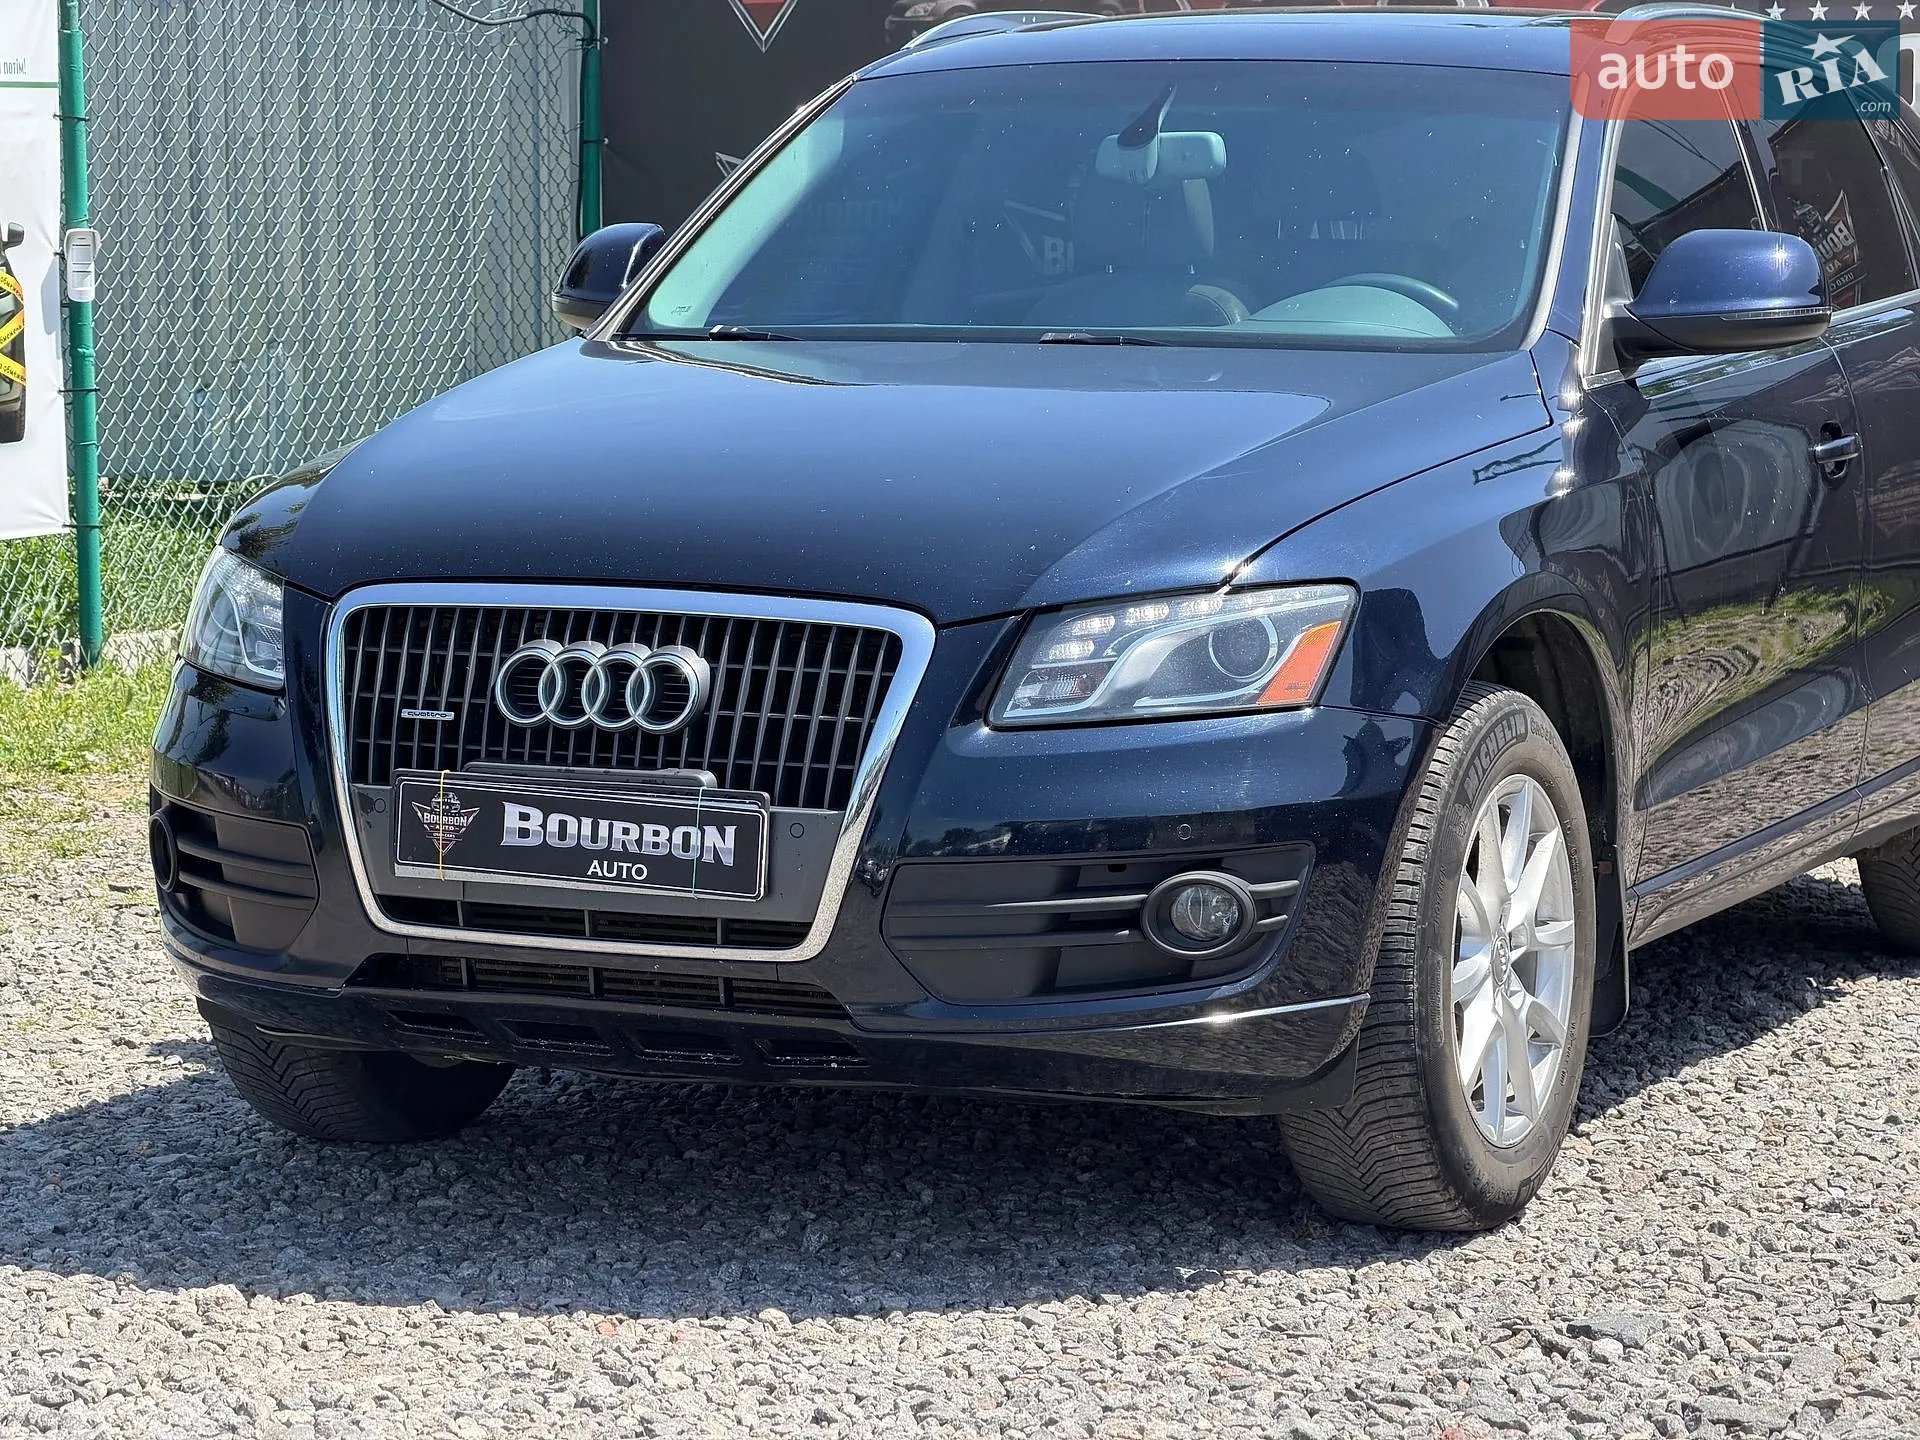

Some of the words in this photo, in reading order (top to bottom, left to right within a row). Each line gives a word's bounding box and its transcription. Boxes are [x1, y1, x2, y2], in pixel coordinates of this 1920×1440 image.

[406, 710, 448, 718] quattro
[1463, 712, 1527, 803] MICHELIN
[423, 812, 467, 827] BOURBON
[501, 801, 737, 867] BOURBON
[587, 859, 648, 881] AUTO
